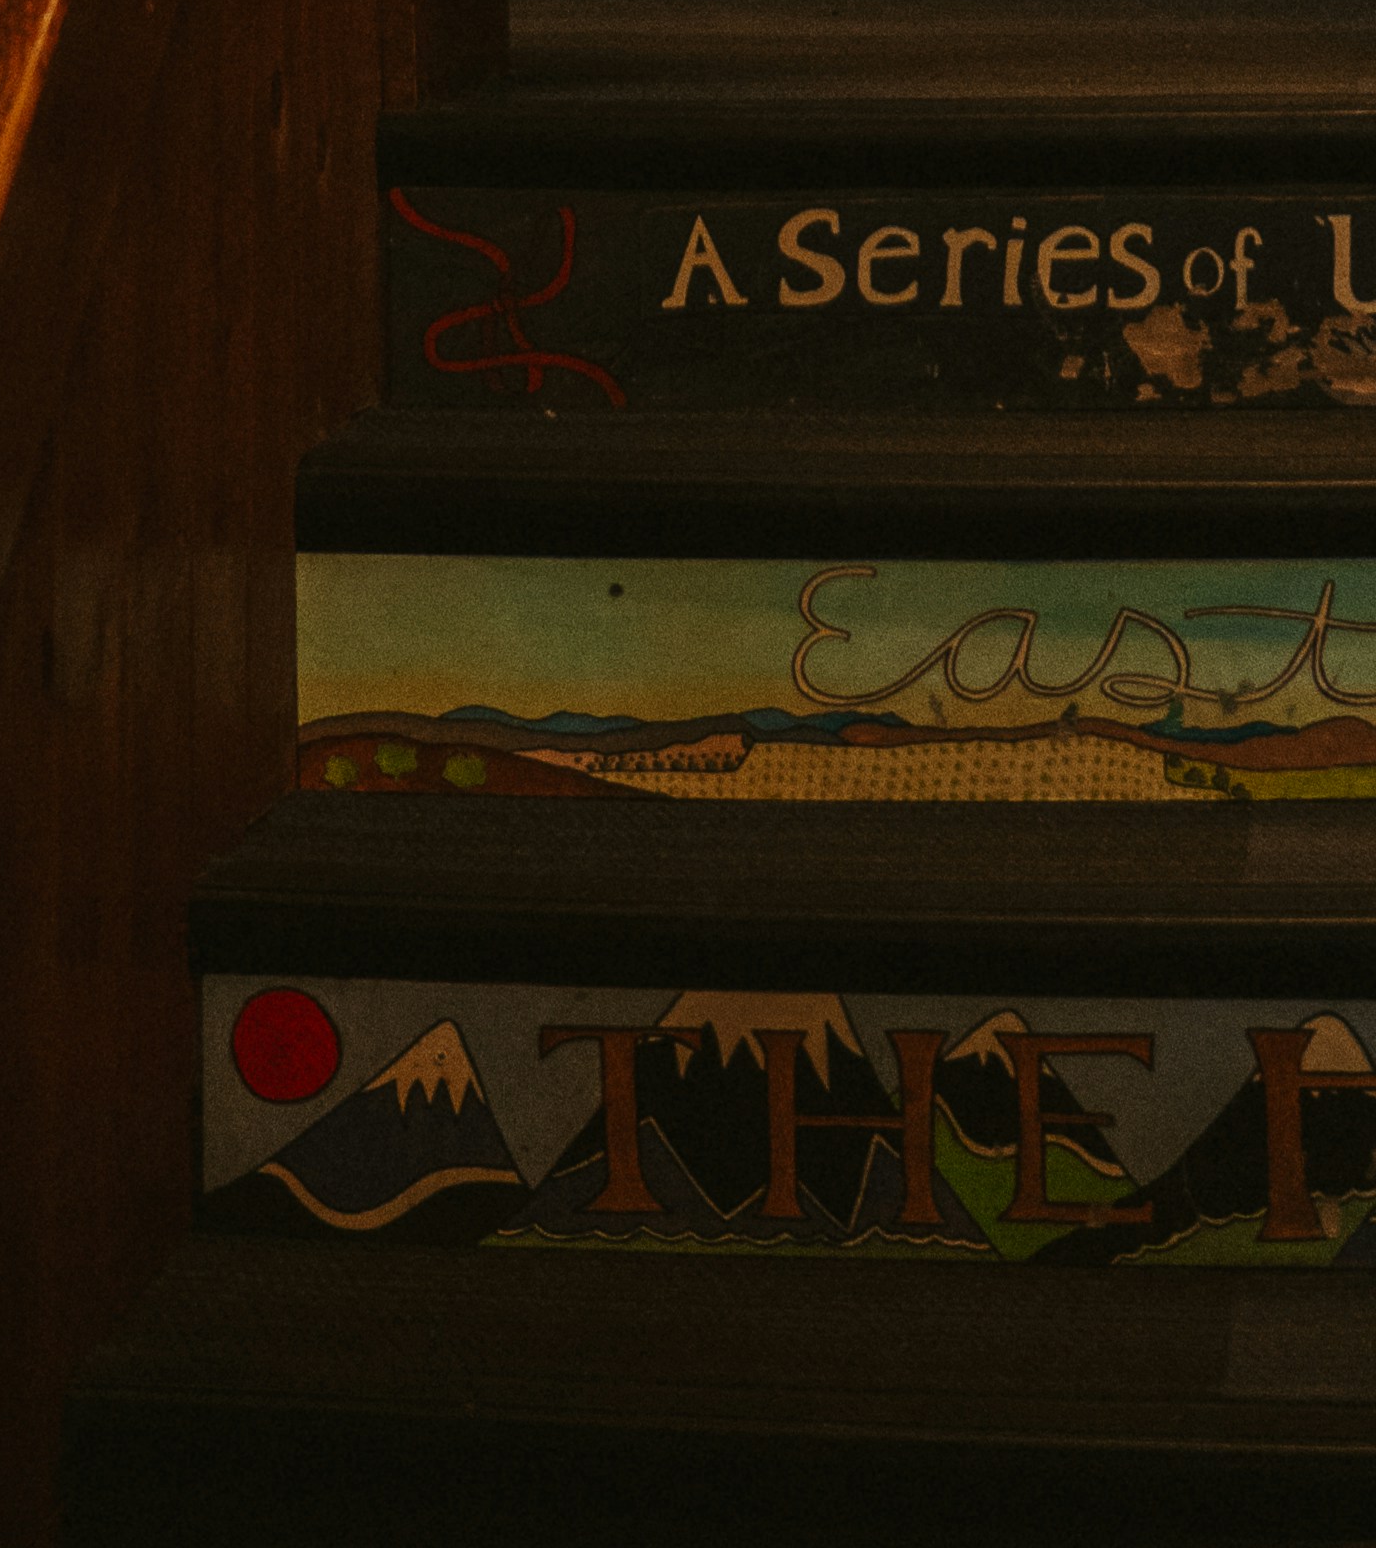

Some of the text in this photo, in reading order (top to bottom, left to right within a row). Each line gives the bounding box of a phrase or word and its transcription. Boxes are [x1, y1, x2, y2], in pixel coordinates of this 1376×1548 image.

[661, 219, 749, 307] A
[777, 209, 1156, 311] Series
[1181, 231, 1264, 307] of
[543, 1021, 1157, 1232] THE
